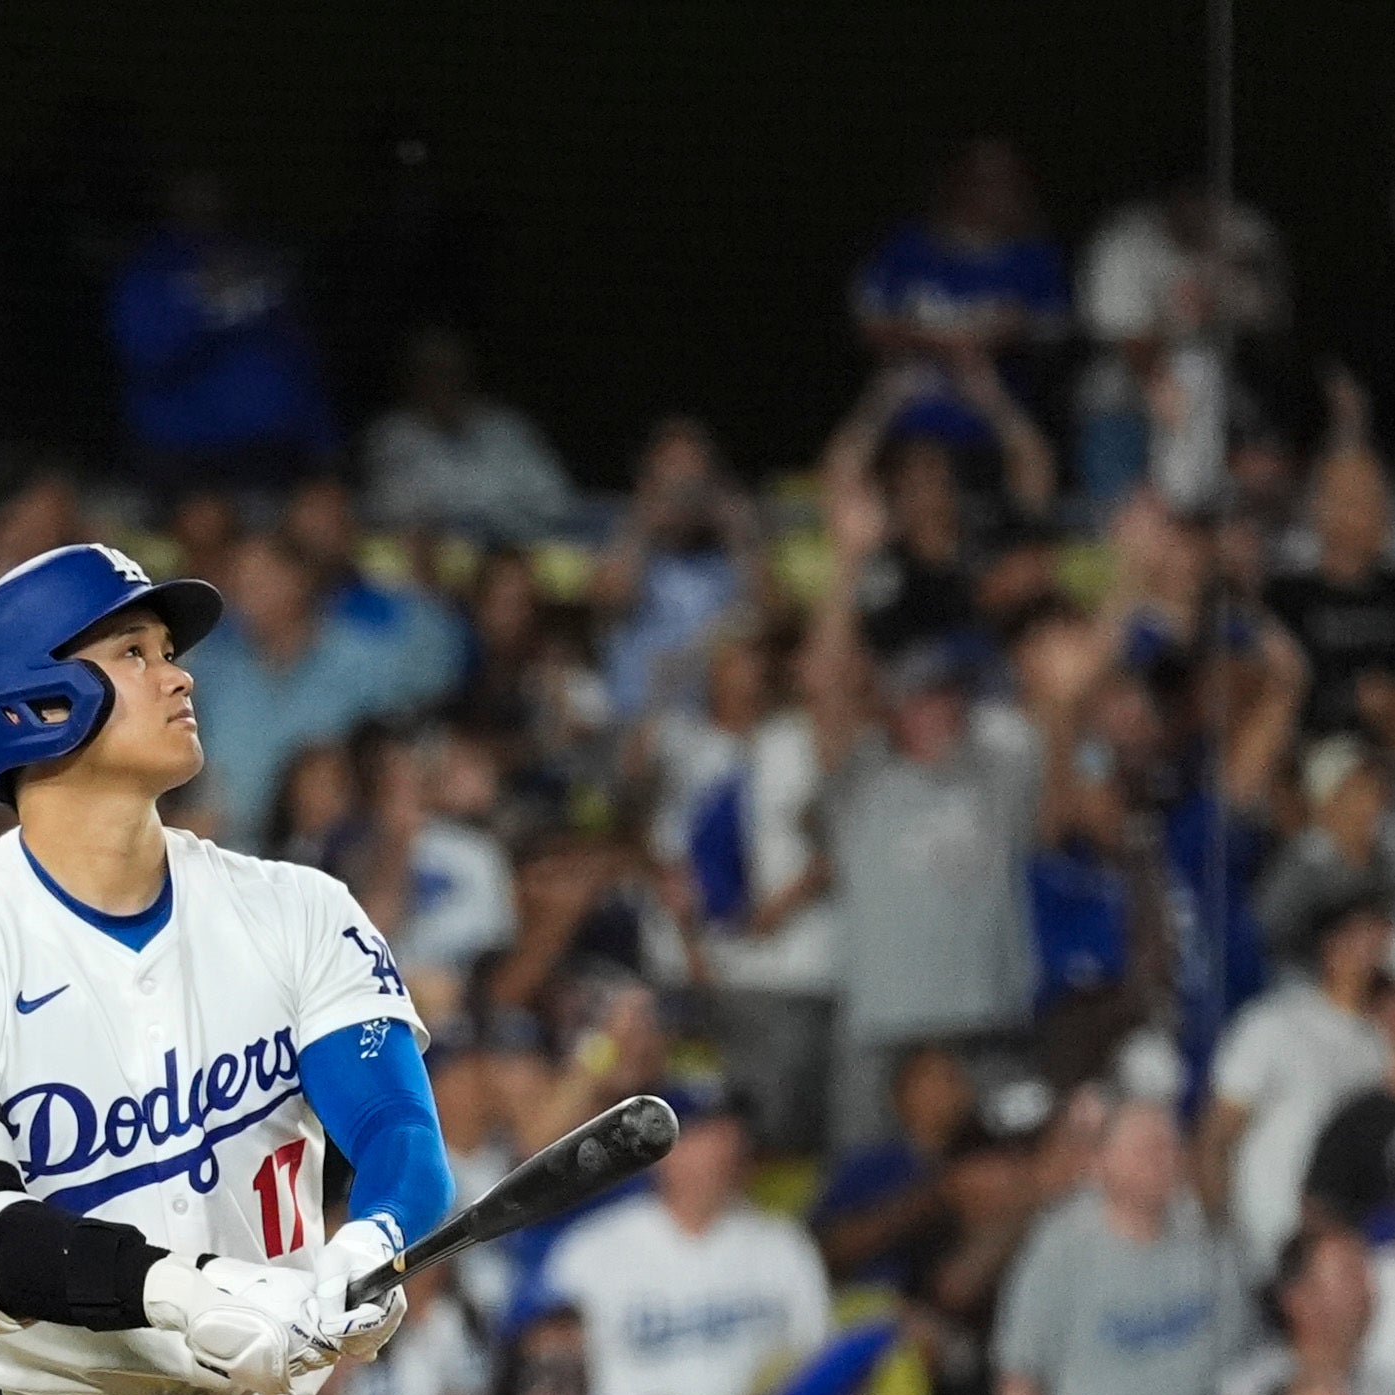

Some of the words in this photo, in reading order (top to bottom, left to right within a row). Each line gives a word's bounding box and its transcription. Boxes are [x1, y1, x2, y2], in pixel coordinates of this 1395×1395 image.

[342, 926, 405, 996] LA
[1, 1026, 302, 1196] Dodgers
[253, 1137, 307, 1260] 17
